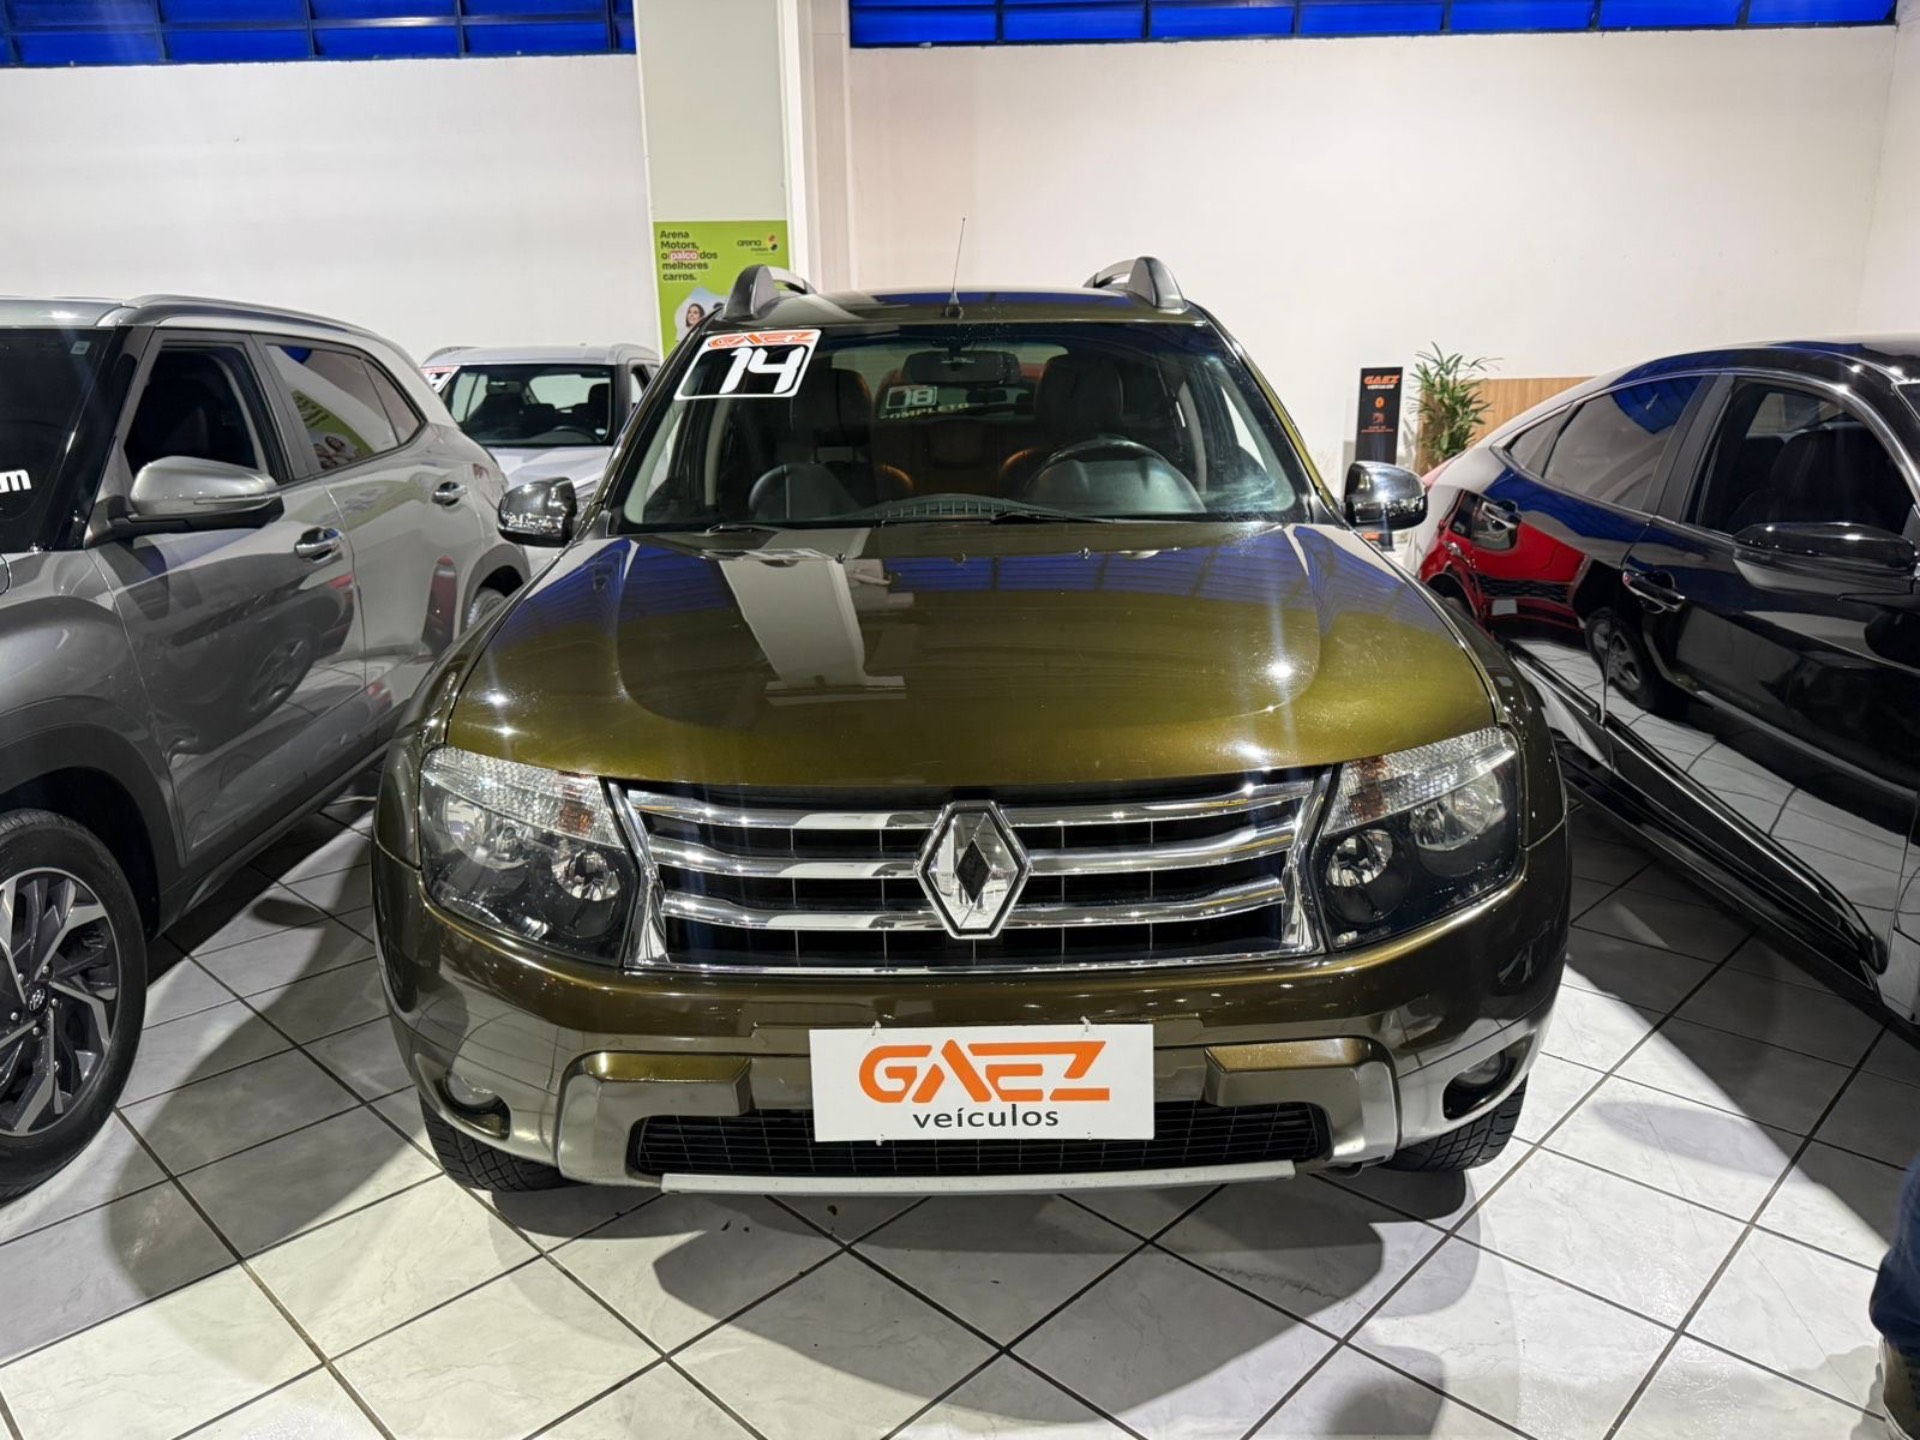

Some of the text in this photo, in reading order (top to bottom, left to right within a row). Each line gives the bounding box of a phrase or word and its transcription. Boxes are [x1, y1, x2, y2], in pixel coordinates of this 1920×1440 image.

[660, 230, 689, 239] Arena
[660, 241, 699, 250] Motors,
[670, 251, 698, 261] palco
[700, 250, 718, 259] dos
[662, 261, 709, 270] melhores
[663, 273, 697, 281] carros.
[719, 346, 805, 394] 14
[859, 1039, 1110, 1103] GAEZ
[912, 1103, 1059, 1128] veículos
